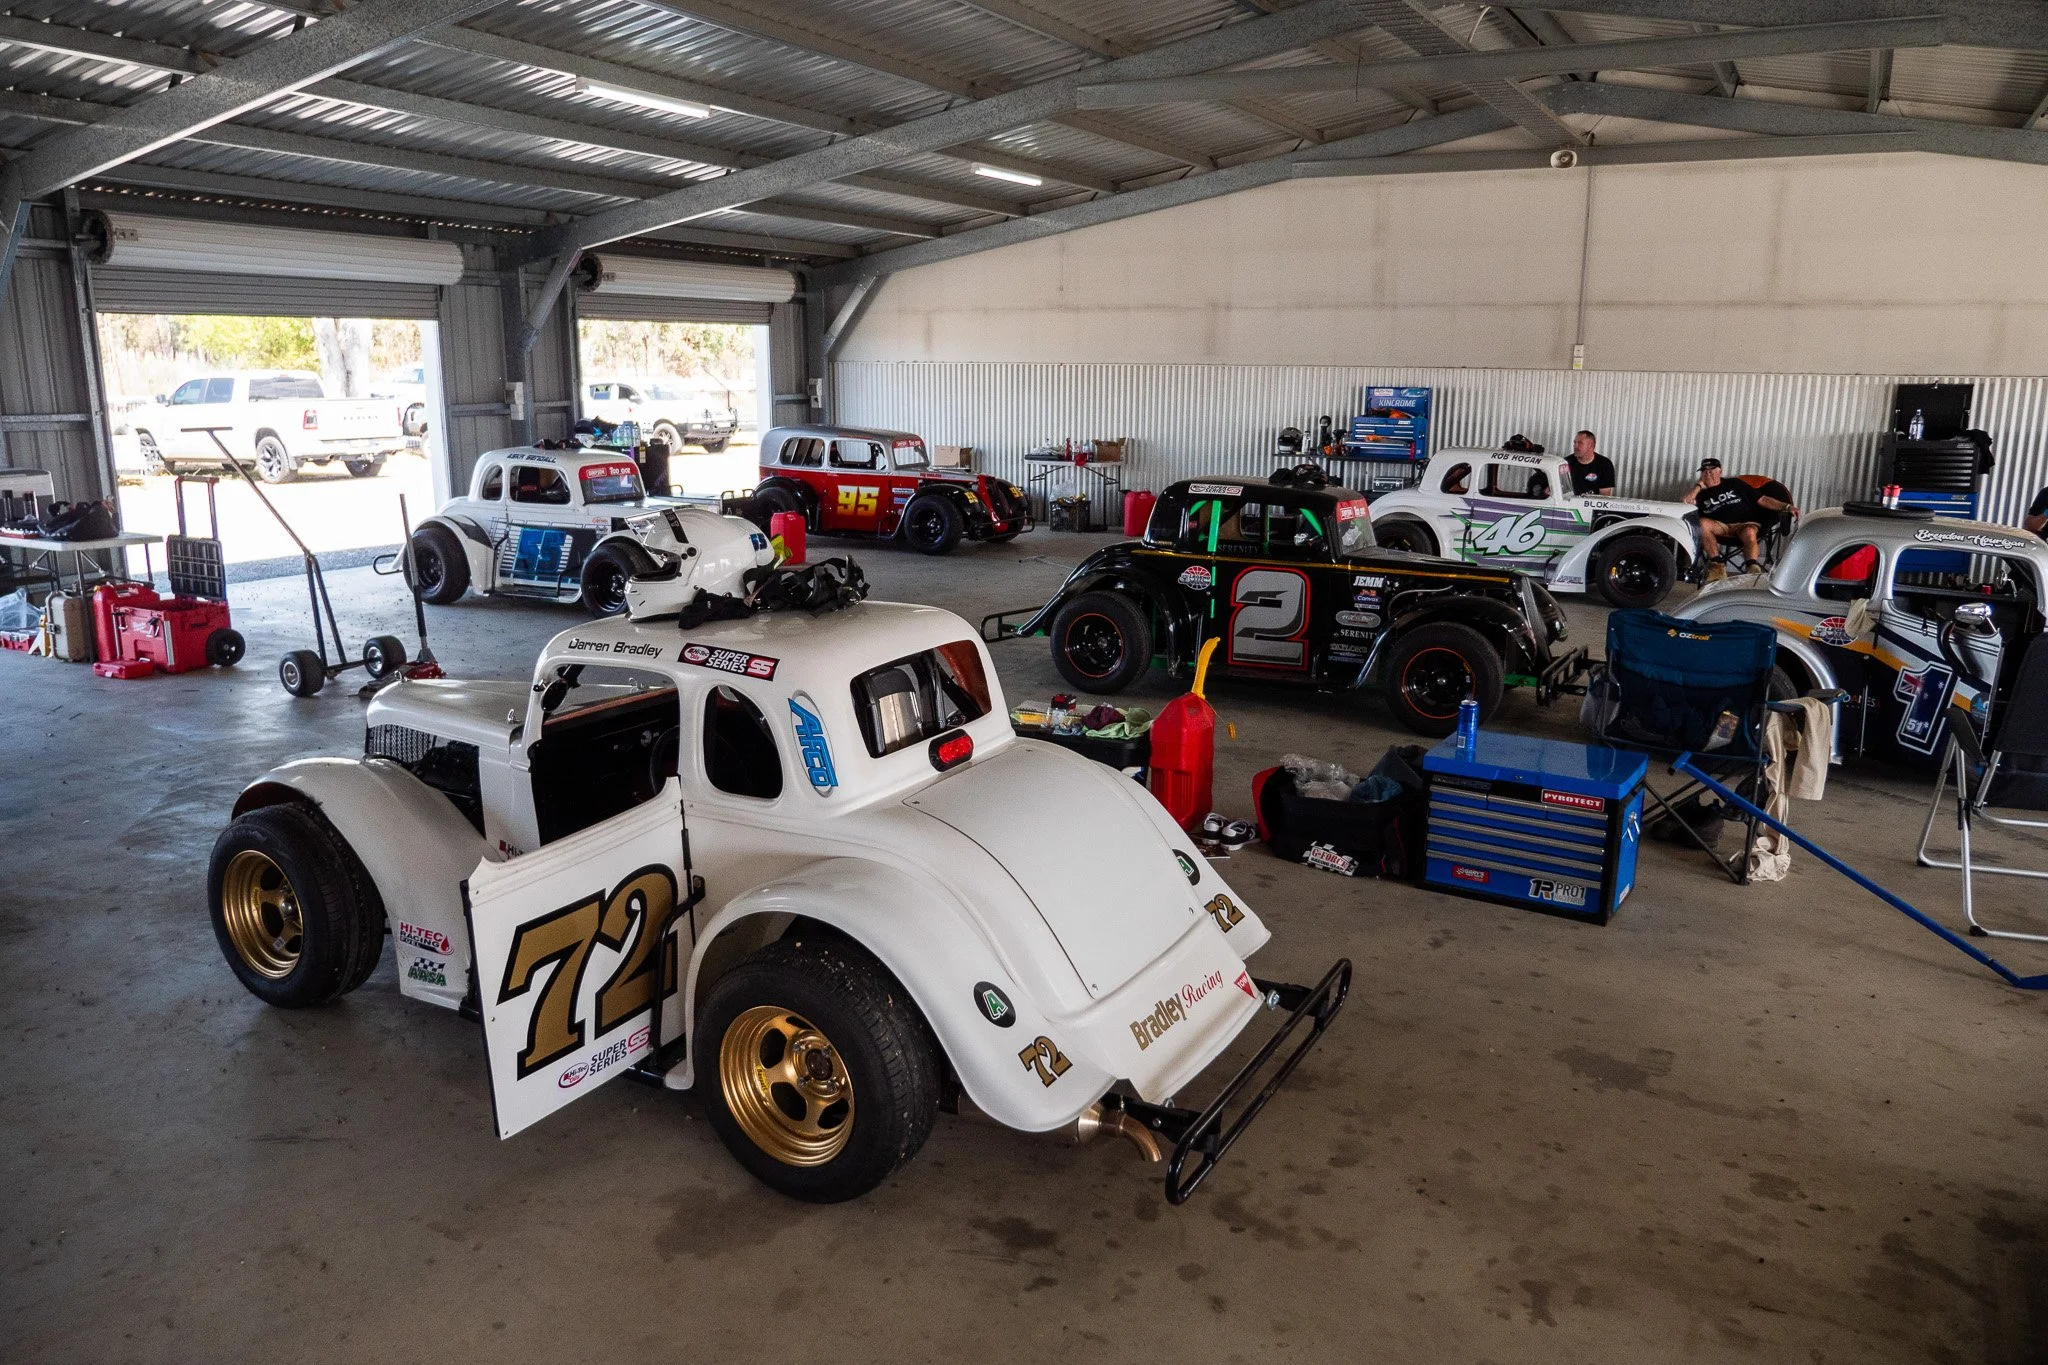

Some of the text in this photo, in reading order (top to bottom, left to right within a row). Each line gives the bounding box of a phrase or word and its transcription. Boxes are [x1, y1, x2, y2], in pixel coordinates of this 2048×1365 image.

[1491, 452, 1542, 465] ROB HOGAN
[837, 485, 880, 516] 95
[1584, 500, 1609, 508] BLOK
[1473, 508, 1547, 556] 46
[1914, 529, 1965, 542] Brendon
[1217, 545, 1260, 553] SERENITY
[1353, 575, 1385, 588] JEMM
[1228, 566, 1311, 671] 2
[568, 638, 663, 659] Darren Bradley
[711, 649, 750, 665] SUPER
[706, 657, 747, 673] SERIES
[1544, 793, 1601, 806] PYROTECT
[1312, 848, 1350, 868] G-FORCE
[1555, 883, 1586, 898] PRO1
[1204, 894, 1245, 933] 72
[400, 930, 440, 948] RACING
[401, 922, 443, 941] HI-TEC
[496, 863, 679, 1082] 72
[983, 989, 1009, 1019] A
[1130, 971, 1224, 1051] Bradley Racing
[589, 1047, 628, 1077] SERIES
[591, 1039, 627, 1065] SUPER
[1018, 1035, 1073, 1088] 72
